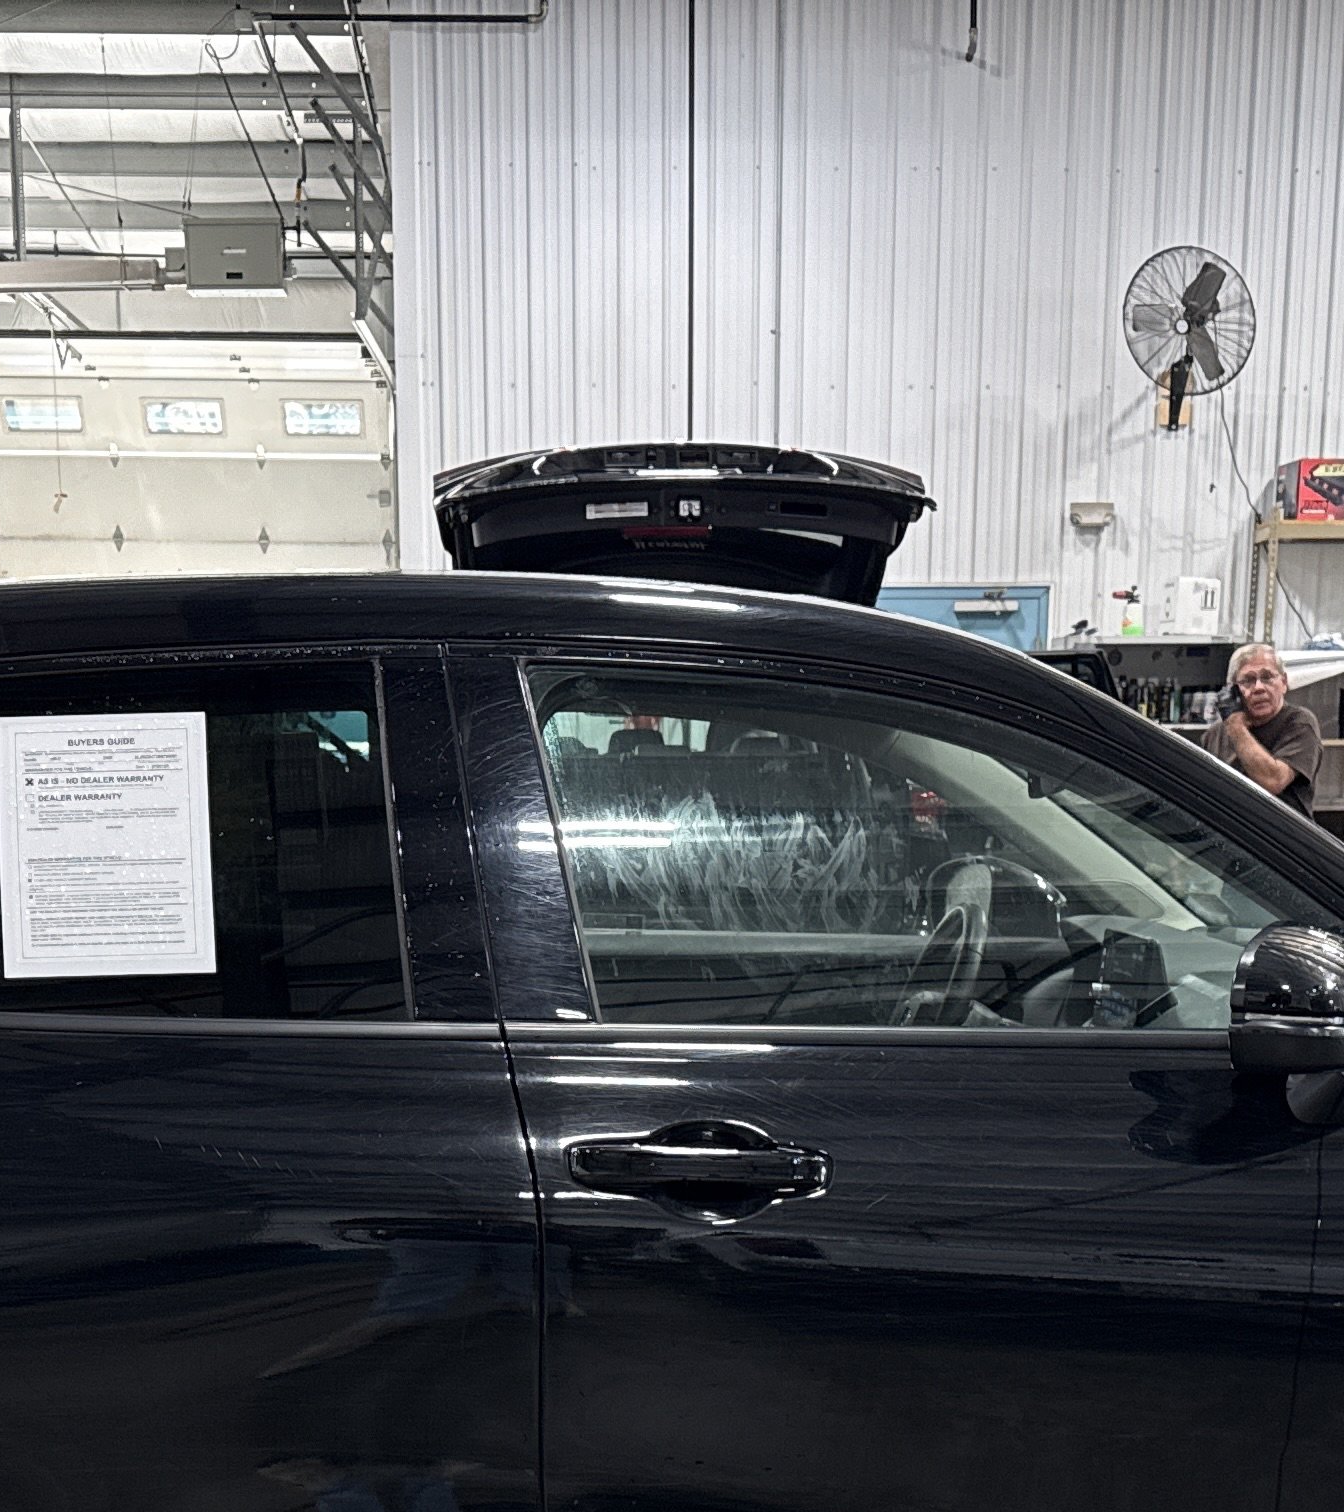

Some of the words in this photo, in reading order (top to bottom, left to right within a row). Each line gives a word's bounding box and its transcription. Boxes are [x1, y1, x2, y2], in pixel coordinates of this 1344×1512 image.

[67, 738, 105, 747] BUYERS
[107, 737, 136, 746] GUIDE
[51, 777, 58, 785] IS
[66, 777, 79, 785] NO
[80, 776, 115, 784] DEALER
[116, 774, 165, 783] WARRANTY
[38, 794, 72, 802] DEALER
[74, 792, 123, 801] WARRANTY
